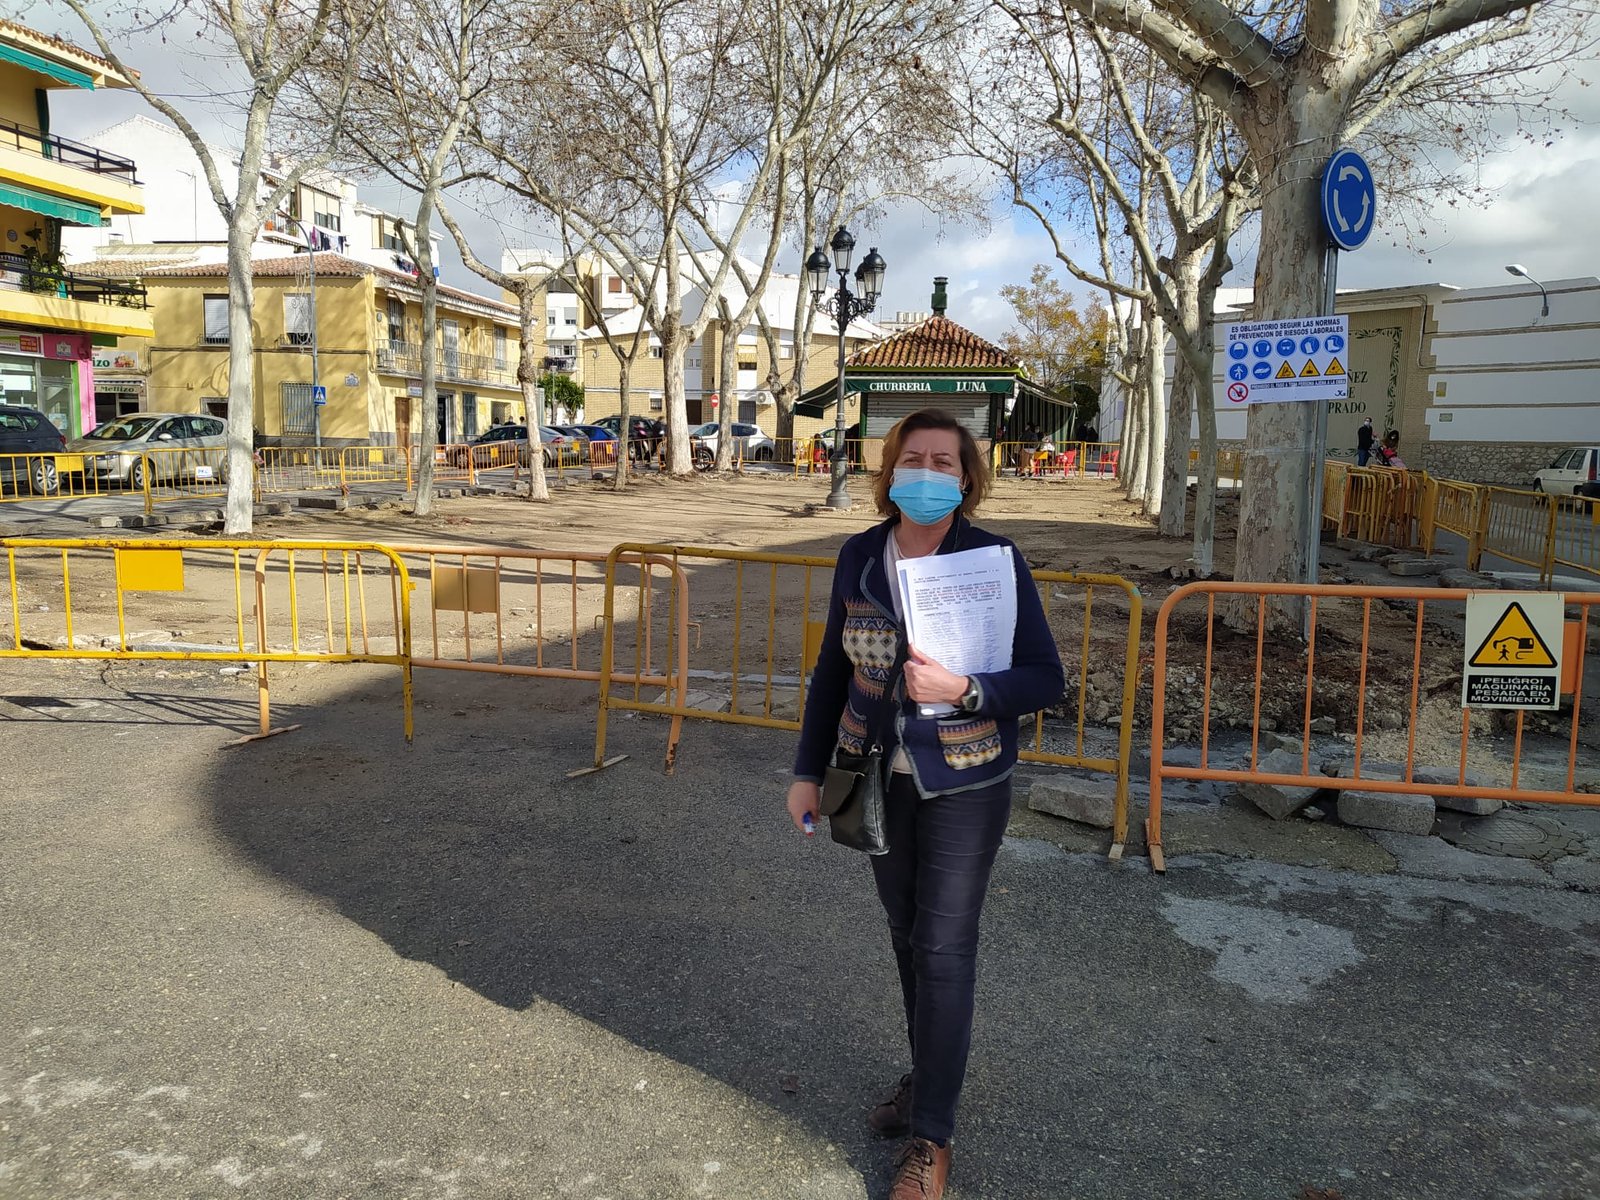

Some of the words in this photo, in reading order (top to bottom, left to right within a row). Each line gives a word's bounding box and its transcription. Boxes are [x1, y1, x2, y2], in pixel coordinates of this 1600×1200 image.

[1240, 324, 1279, 333] OBLIGATORIO
[1280, 321, 1301, 329] SEGUIR
[1302, 320, 1314, 328] LAS
[1315, 318, 1340, 327] NORMAS
[1238, 330, 1274, 340] PREVENCION
[1275, 329, 1283, 337] DE
[1284, 327, 1309, 336] RIESGOS
[1310, 325, 1344, 335] LABORALES
[869, 382, 932, 391] CHURRERIA
[956, 381, 987, 392] LUNA
[1328, 401, 1367, 414] PRADO
[1471, 683, 1552, 691] MAQUINARIA
[1470, 695, 1551, 703] MOVIMIENTO
